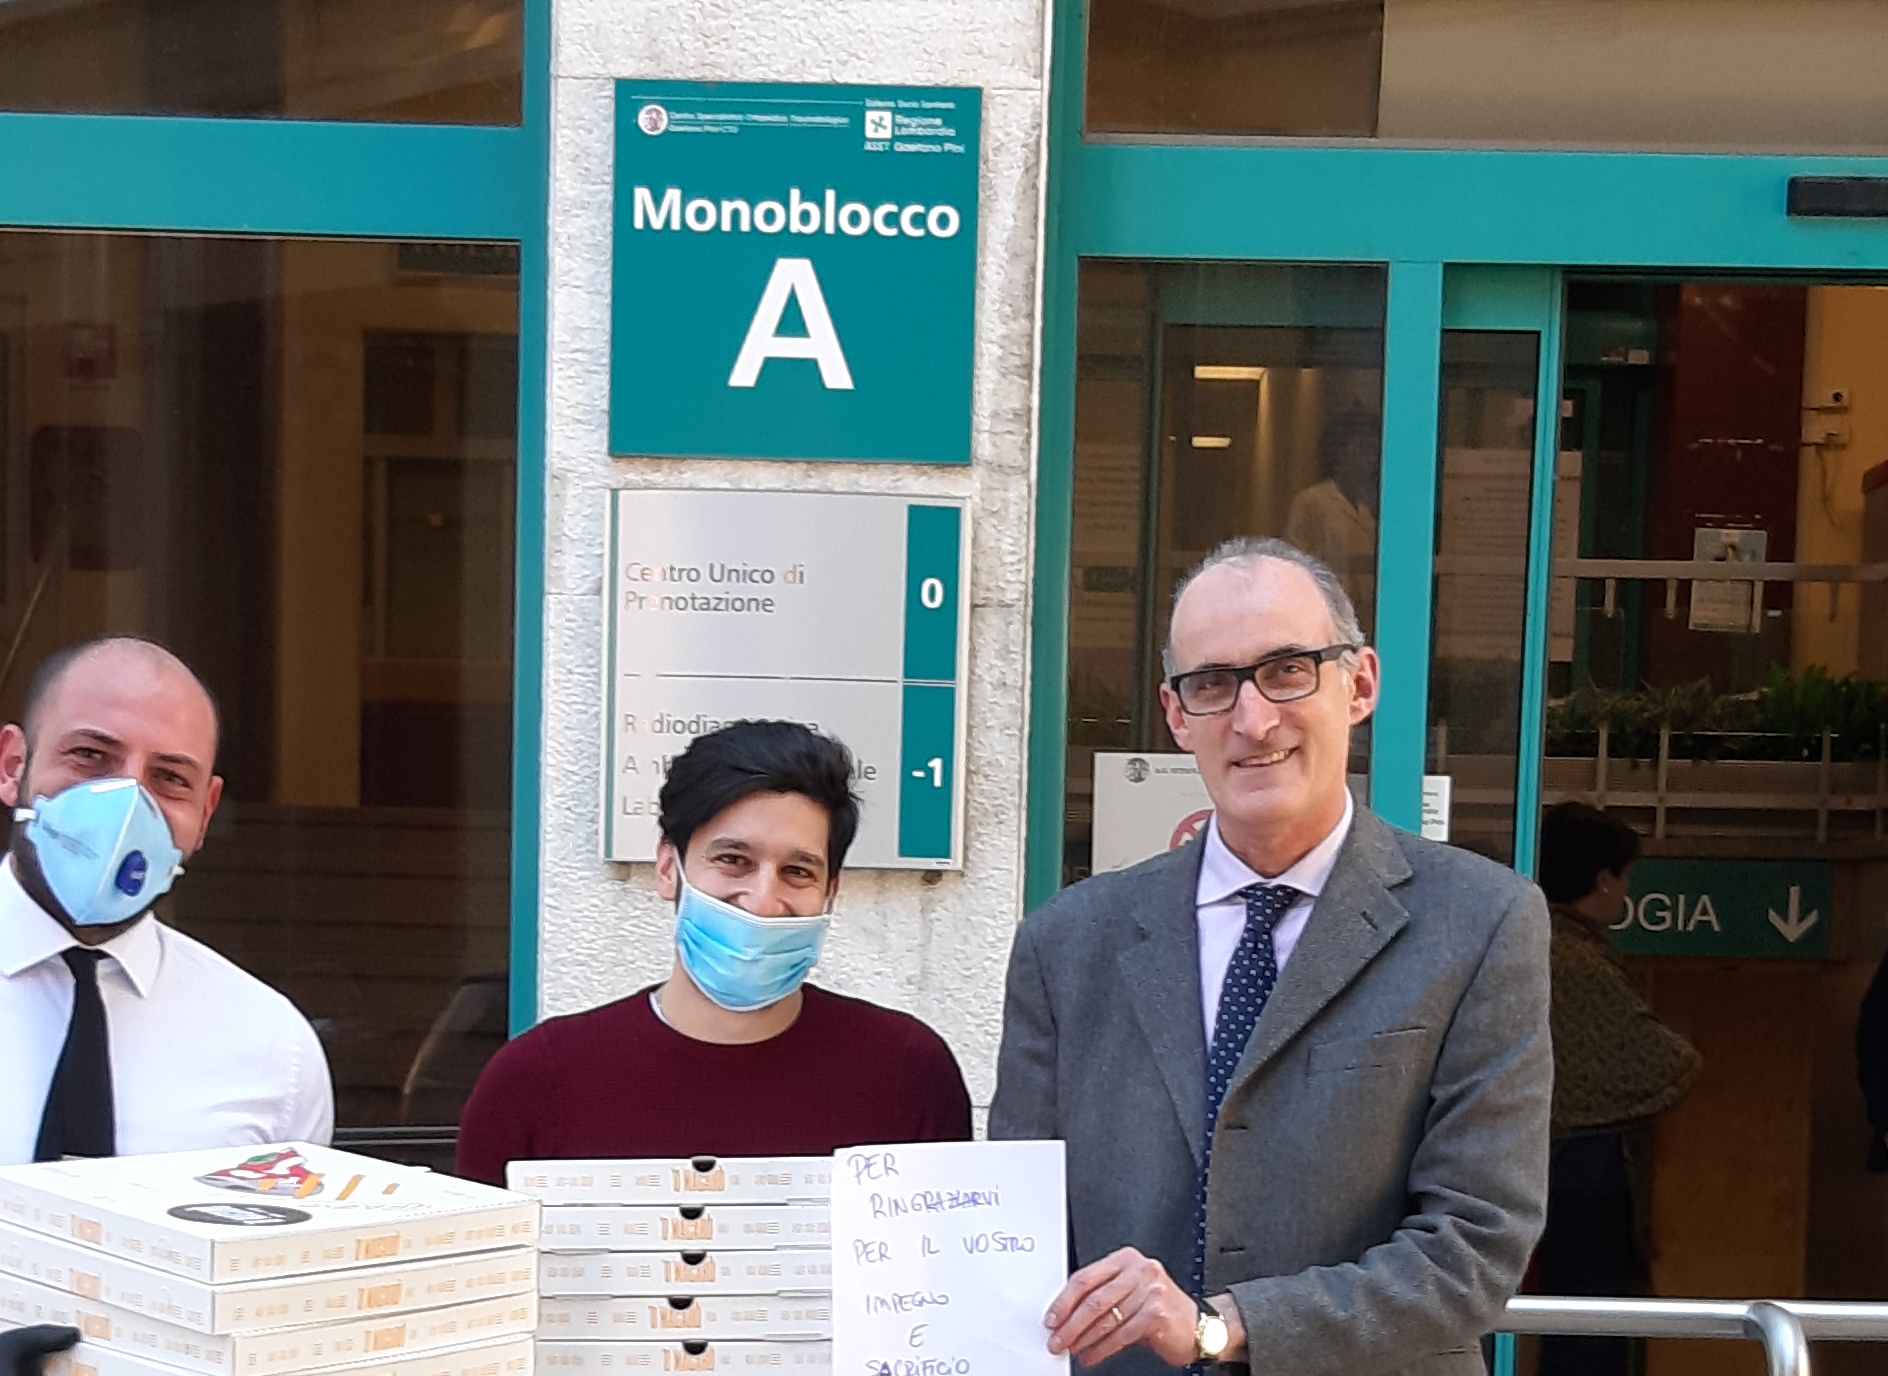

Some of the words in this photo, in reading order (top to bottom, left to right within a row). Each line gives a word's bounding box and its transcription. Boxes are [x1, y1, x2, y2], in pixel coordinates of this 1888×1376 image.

[632, 187, 960, 238] Monoblocco
[728, 258, 854, 390] A
[708, 562, 775, 584] Unico
[784, 563, 805, 584] di
[920, 578, 944, 609] 0
[911, 758, 944, 787] -1
[848, 1152, 900, 1185] PER
[852, 1238, 891, 1266] PER
[921, 1234, 940, 1257] IL
[962, 1231, 1036, 1254] VOSTRO
[865, 1292, 949, 1314] IMPEGNO
[908, 1324, 929, 1348] E
